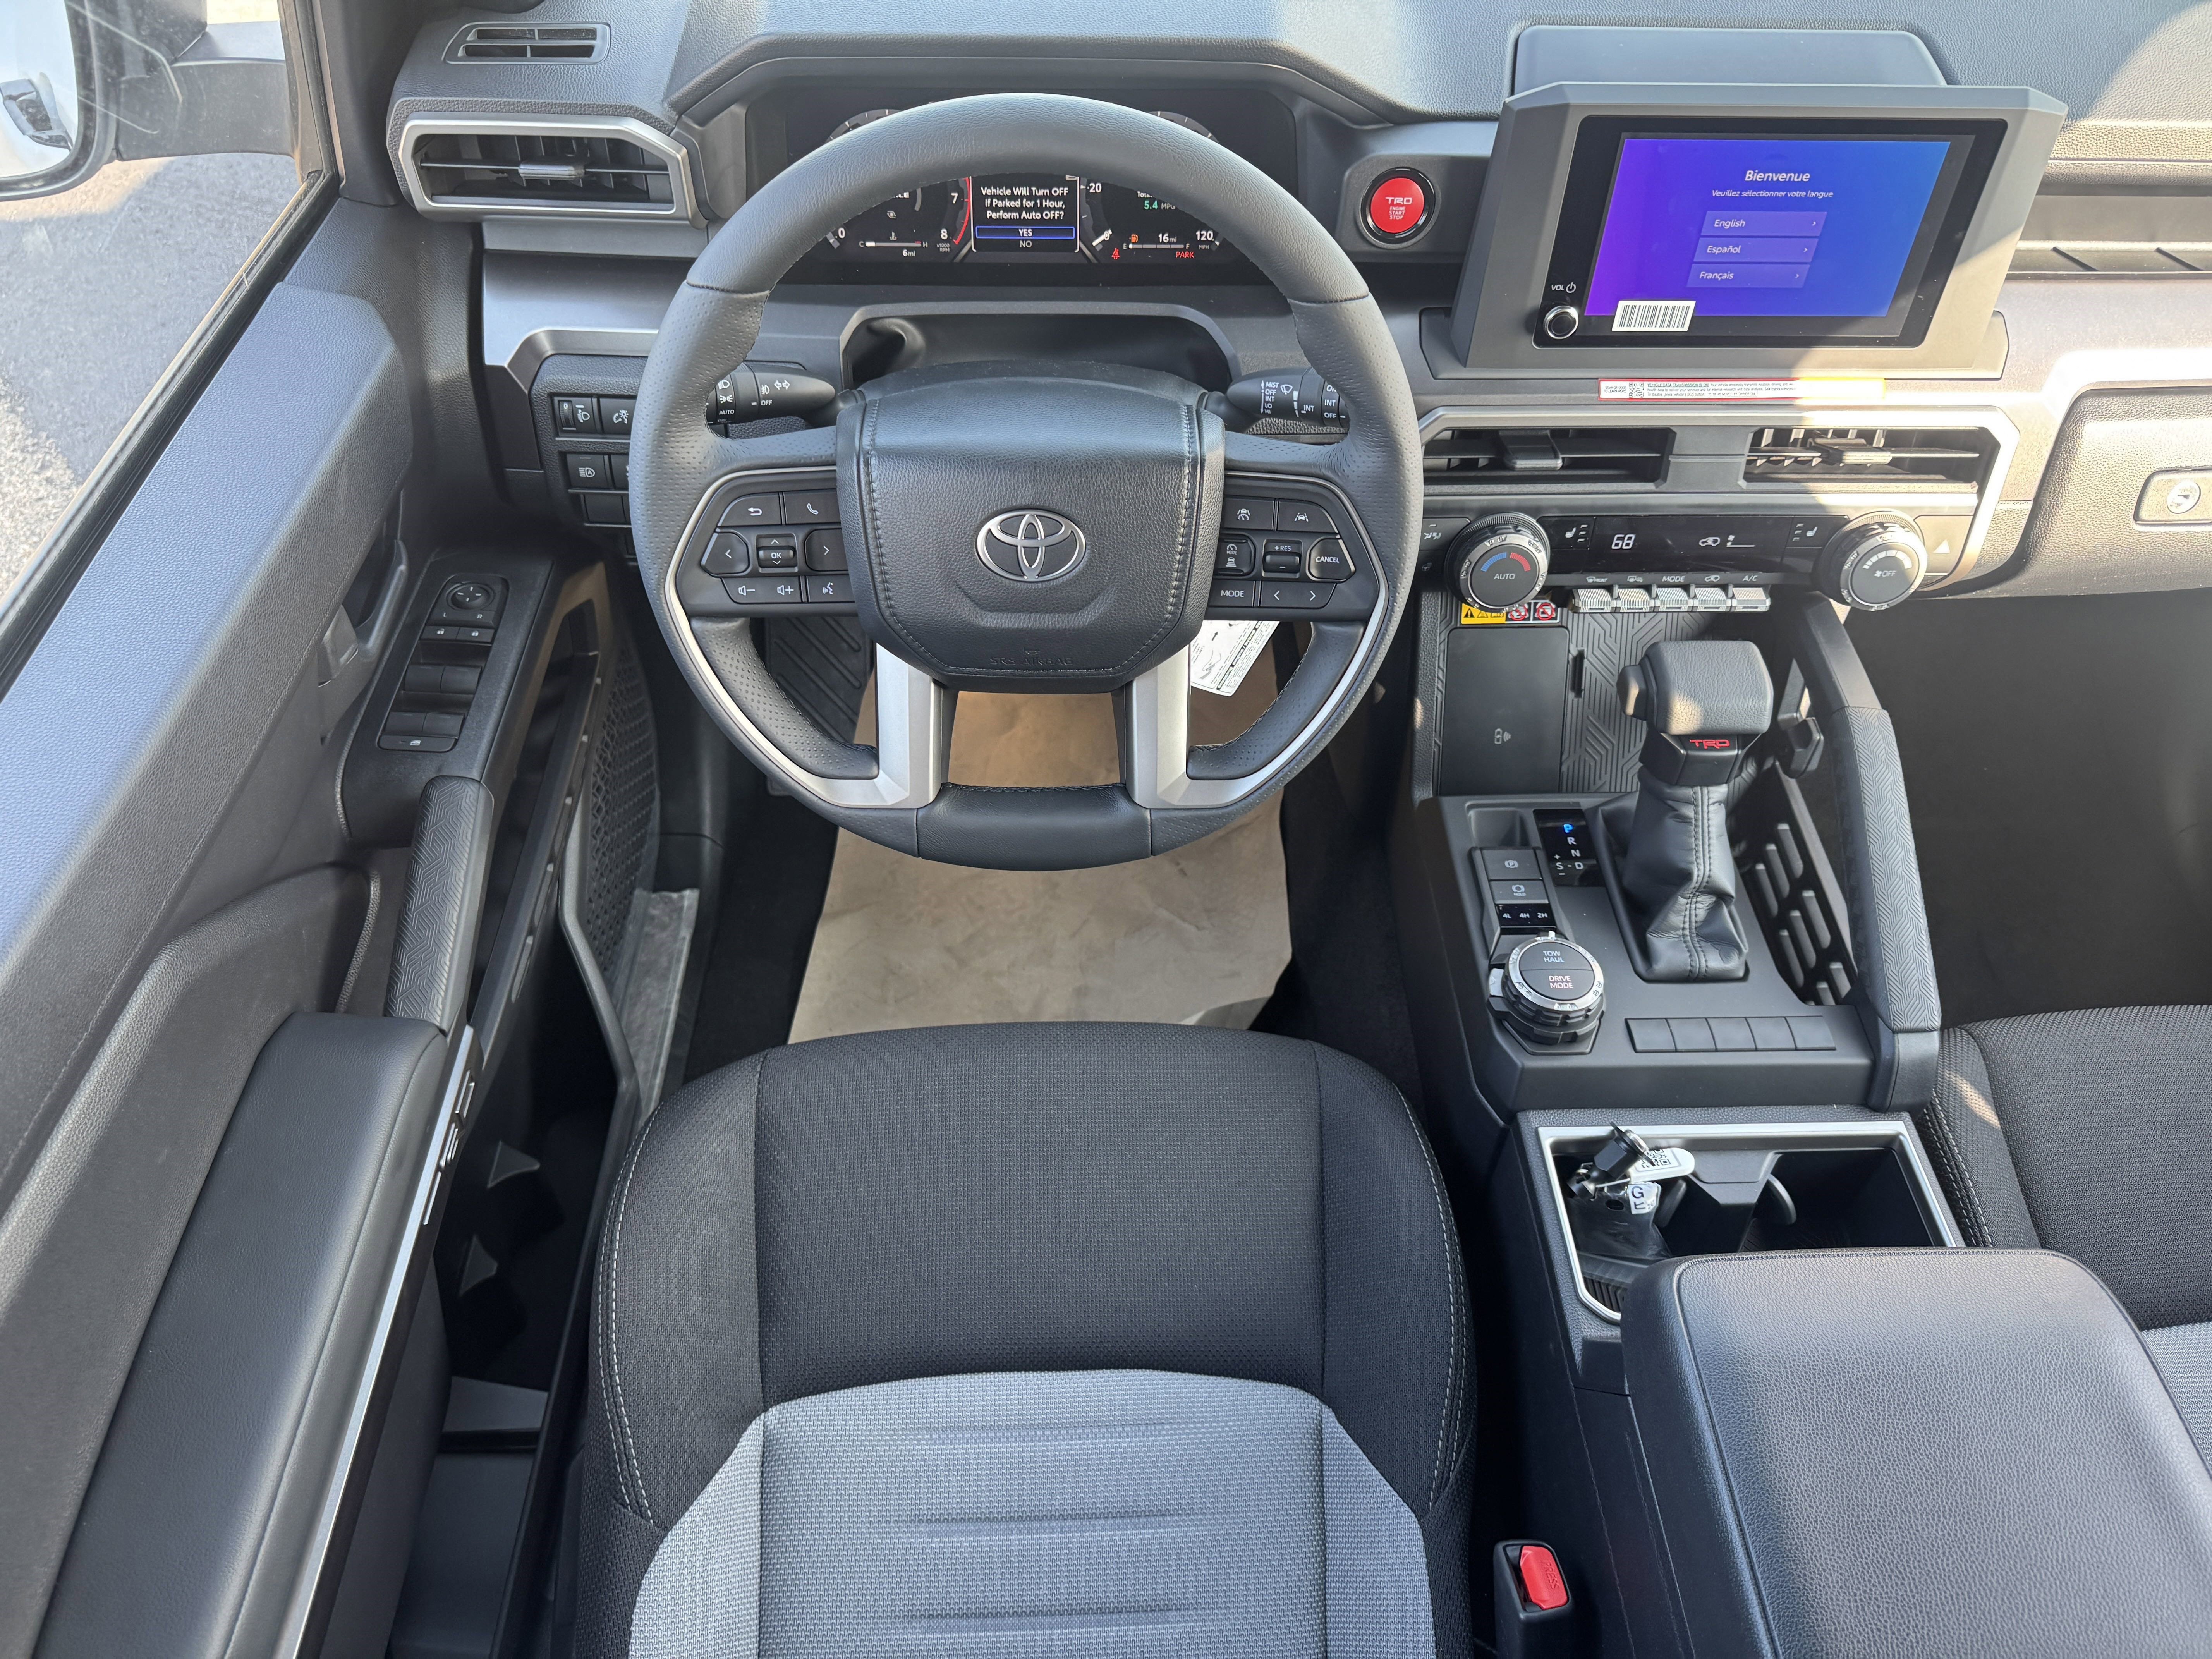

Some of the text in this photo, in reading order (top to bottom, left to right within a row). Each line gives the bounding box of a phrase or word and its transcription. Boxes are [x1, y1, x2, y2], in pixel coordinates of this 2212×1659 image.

[1745, 170, 1810, 182] Bienvenue
[981, 186, 1068, 196] Vehicle Will Turn OFF
[1089, 183, 1102, 193] 20
[951, 193, 958, 204] 7
[1807, 191, 1834, 199] langue
[993, 199, 1020, 208] Parked
[1023, 198, 1035, 208] for
[1037, 199, 1040, 208] 1
[1043, 199, 1065, 209] Hour,
[1144, 200, 1158, 210] 5.4
[987, 210, 1064, 220] Perform Auto OFF?
[1714, 219, 1745, 229] English
[838, 228, 845, 239] 0
[941, 229, 948, 240] 8
[1195, 230, 1214, 241] 120
[1707, 245, 1741, 255] Español
[1699, 271, 1734, 281] Français
[1611, 534, 1635, 549] 68
[990, 657, 1073, 666] SRS AIRBAG
[1690, 739, 1730, 749] TRD
[1563, 824, 1574, 833] P
[1567, 837, 1577, 845] R
[1631, 1185, 1645, 1199] G
[1542, 1560, 1559, 1589] PRESS
